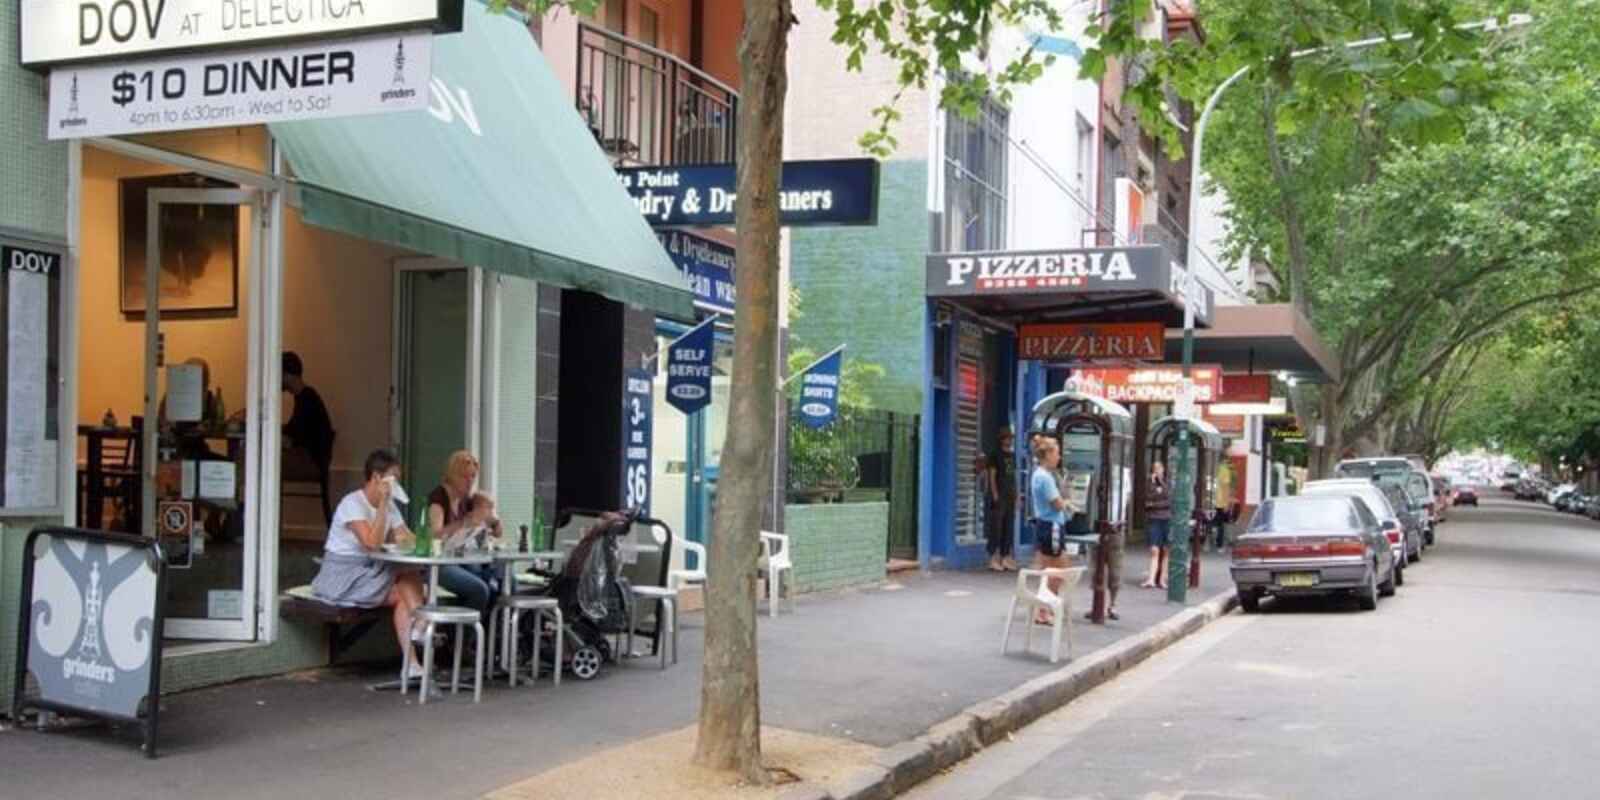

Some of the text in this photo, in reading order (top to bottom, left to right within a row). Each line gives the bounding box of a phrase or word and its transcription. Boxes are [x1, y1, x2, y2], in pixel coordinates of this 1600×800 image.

[79, 0, 165, 46] DOV
[180, 13, 202, 35] AT
[112, 51, 355, 108] $10 DINNER
[130, 111, 160, 126] 4pm
[164, 108, 178, 122] to
[249, 98, 284, 116] Wed
[288, 97, 304, 110] to
[307, 95, 333, 111] Sat
[637, 169, 680, 188] Point
[681, 187, 702, 214] &
[11, 250, 53, 273] DOV
[946, 252, 1136, 285] PIZZERIA
[675, 349, 705, 361] SELF
[1023, 335, 1156, 356] PIZZERIA
[670, 363, 711, 377] SERVE
[1107, 381, 1212, 401] BACKPACRS
[63, 656, 115, 684] grinders
